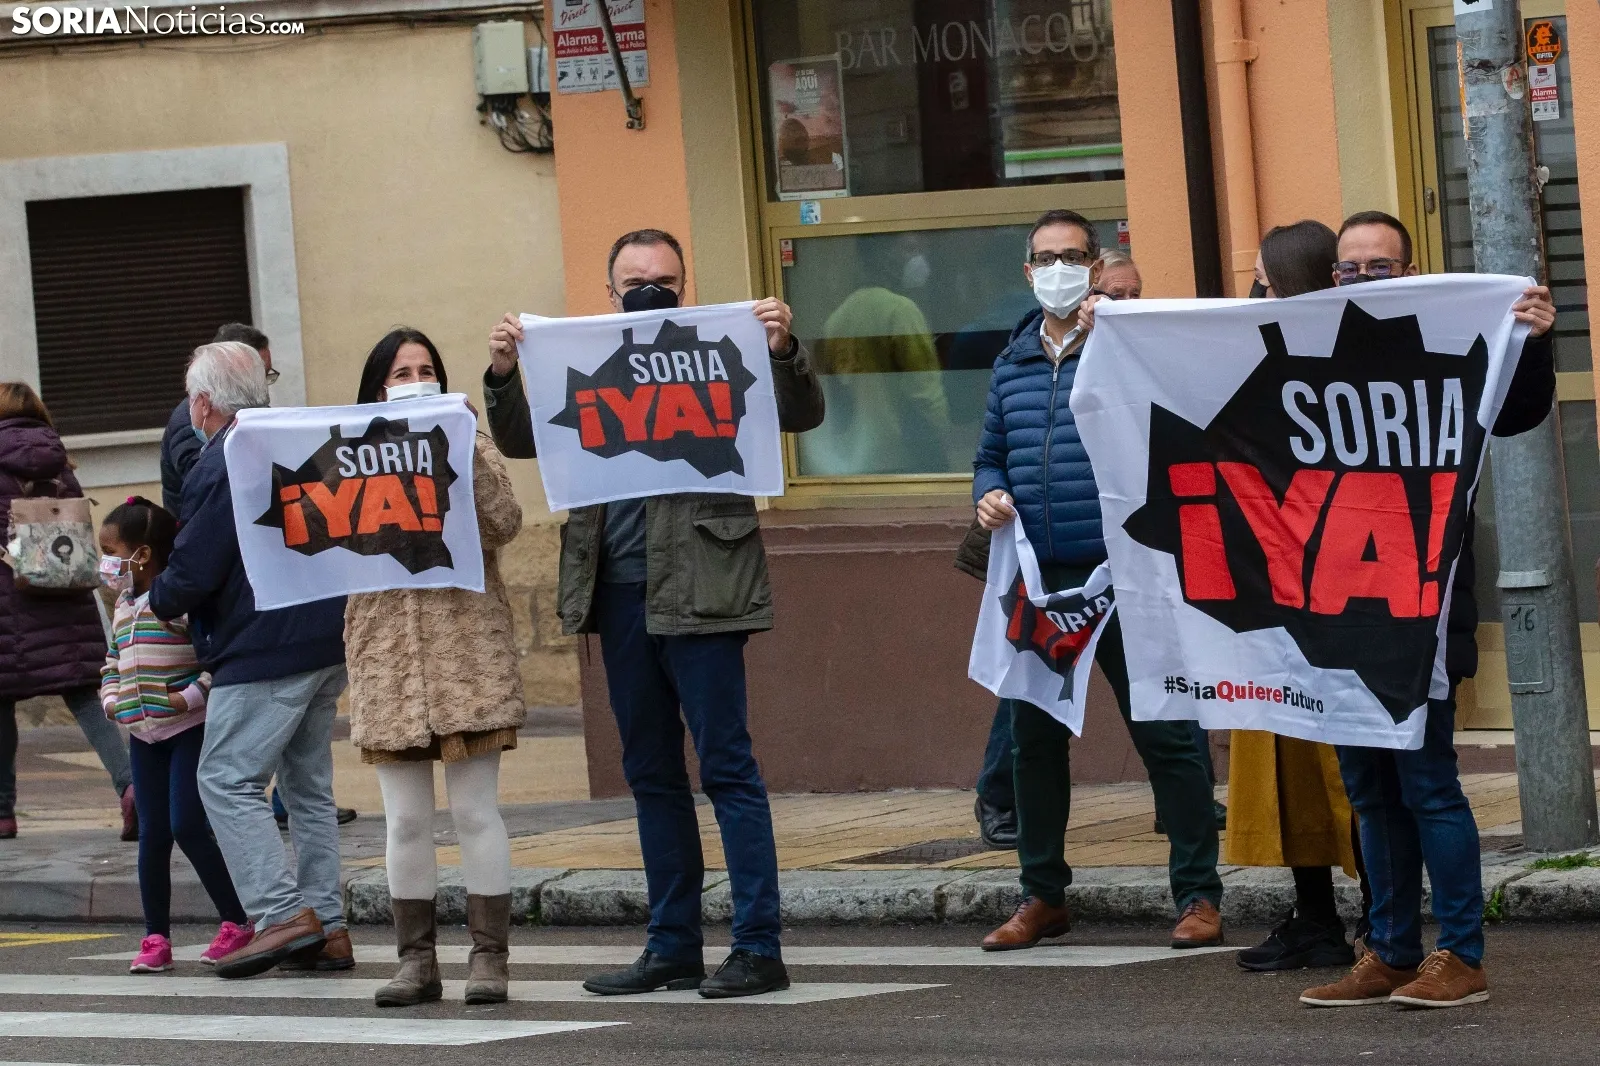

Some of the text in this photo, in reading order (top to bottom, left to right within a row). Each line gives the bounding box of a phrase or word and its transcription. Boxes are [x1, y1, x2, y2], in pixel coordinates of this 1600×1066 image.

[560, 4, 590, 25] Direct
[557, 33, 598, 47] Alarma
[835, 12, 1073, 70] BAR MONACO
[795, 73, 818, 91] AQUÍ
[1532, 88, 1557, 98] Alarma
[628, 349, 729, 384] SORIA
[575, 382, 736, 448] ¡YA!
[1281, 377, 1464, 467] SORIA
[335, 439, 433, 478] SORIA
[280, 474, 443, 547] ¡YA!
[1168, 461, 1458, 618] ¡YA!
[1046, 595, 1111, 633] ORIA
[1511, 606, 1535, 632] 16
